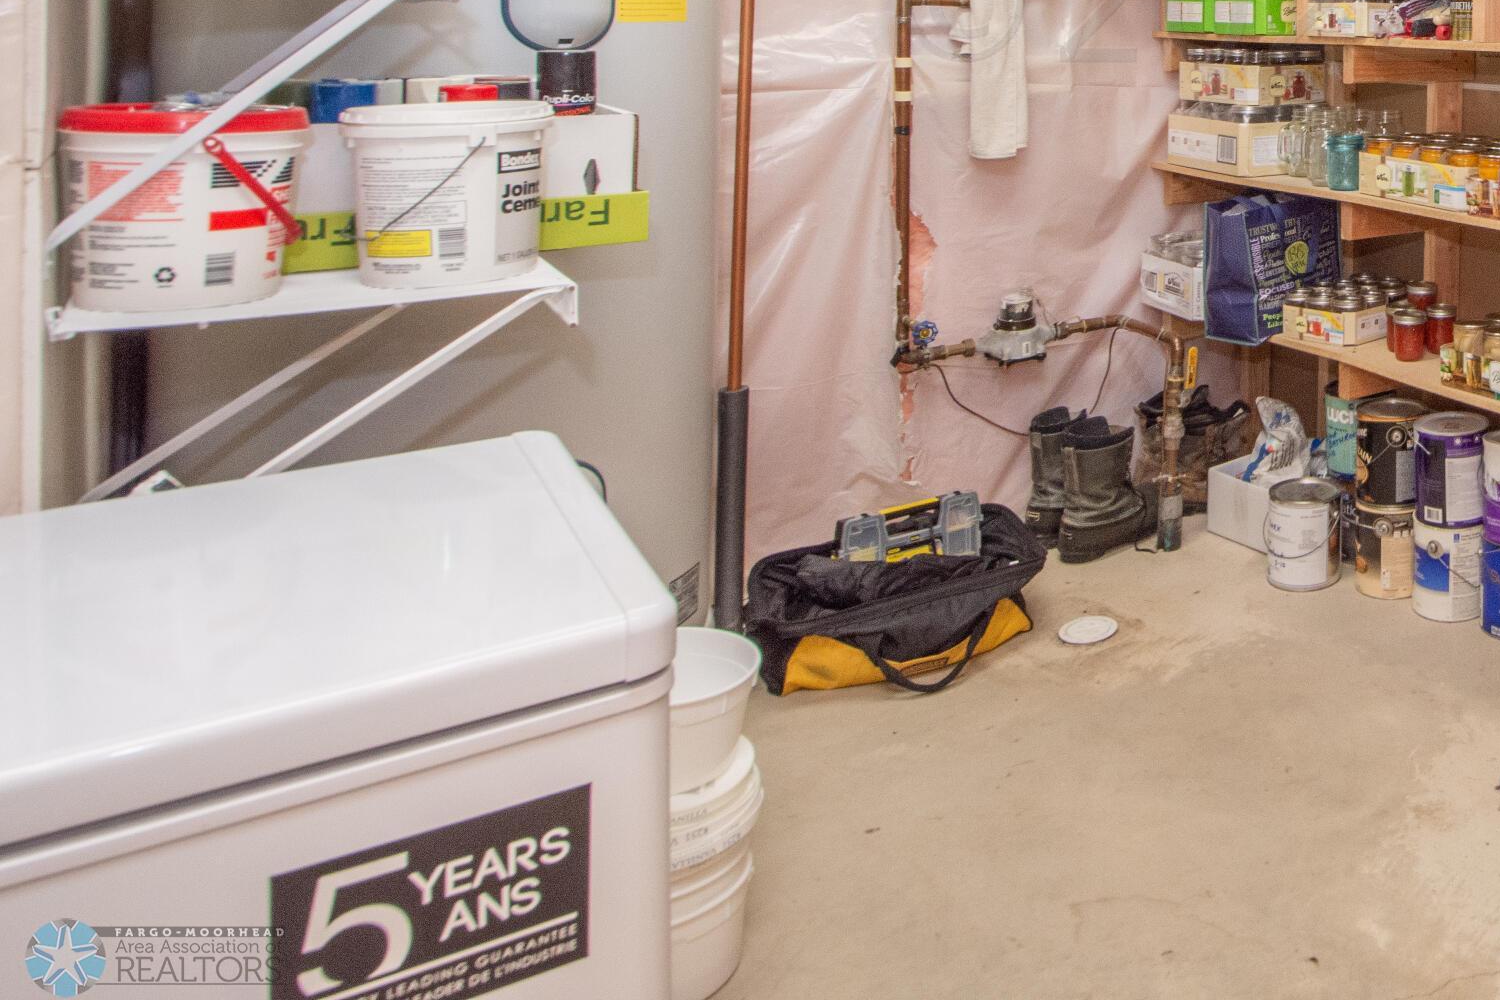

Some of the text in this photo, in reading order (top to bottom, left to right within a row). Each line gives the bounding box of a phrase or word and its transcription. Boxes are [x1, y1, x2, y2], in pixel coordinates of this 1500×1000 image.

[1259, 281, 1295, 297] FOCUSED
[407, 826, 571, 906] YEARS
[296, 850, 414, 998] 5
[439, 876, 542, 943] ANS
[386, 922, 579, 998] LEADING GUARANTEE
[468, 969, 491, 988] DE
